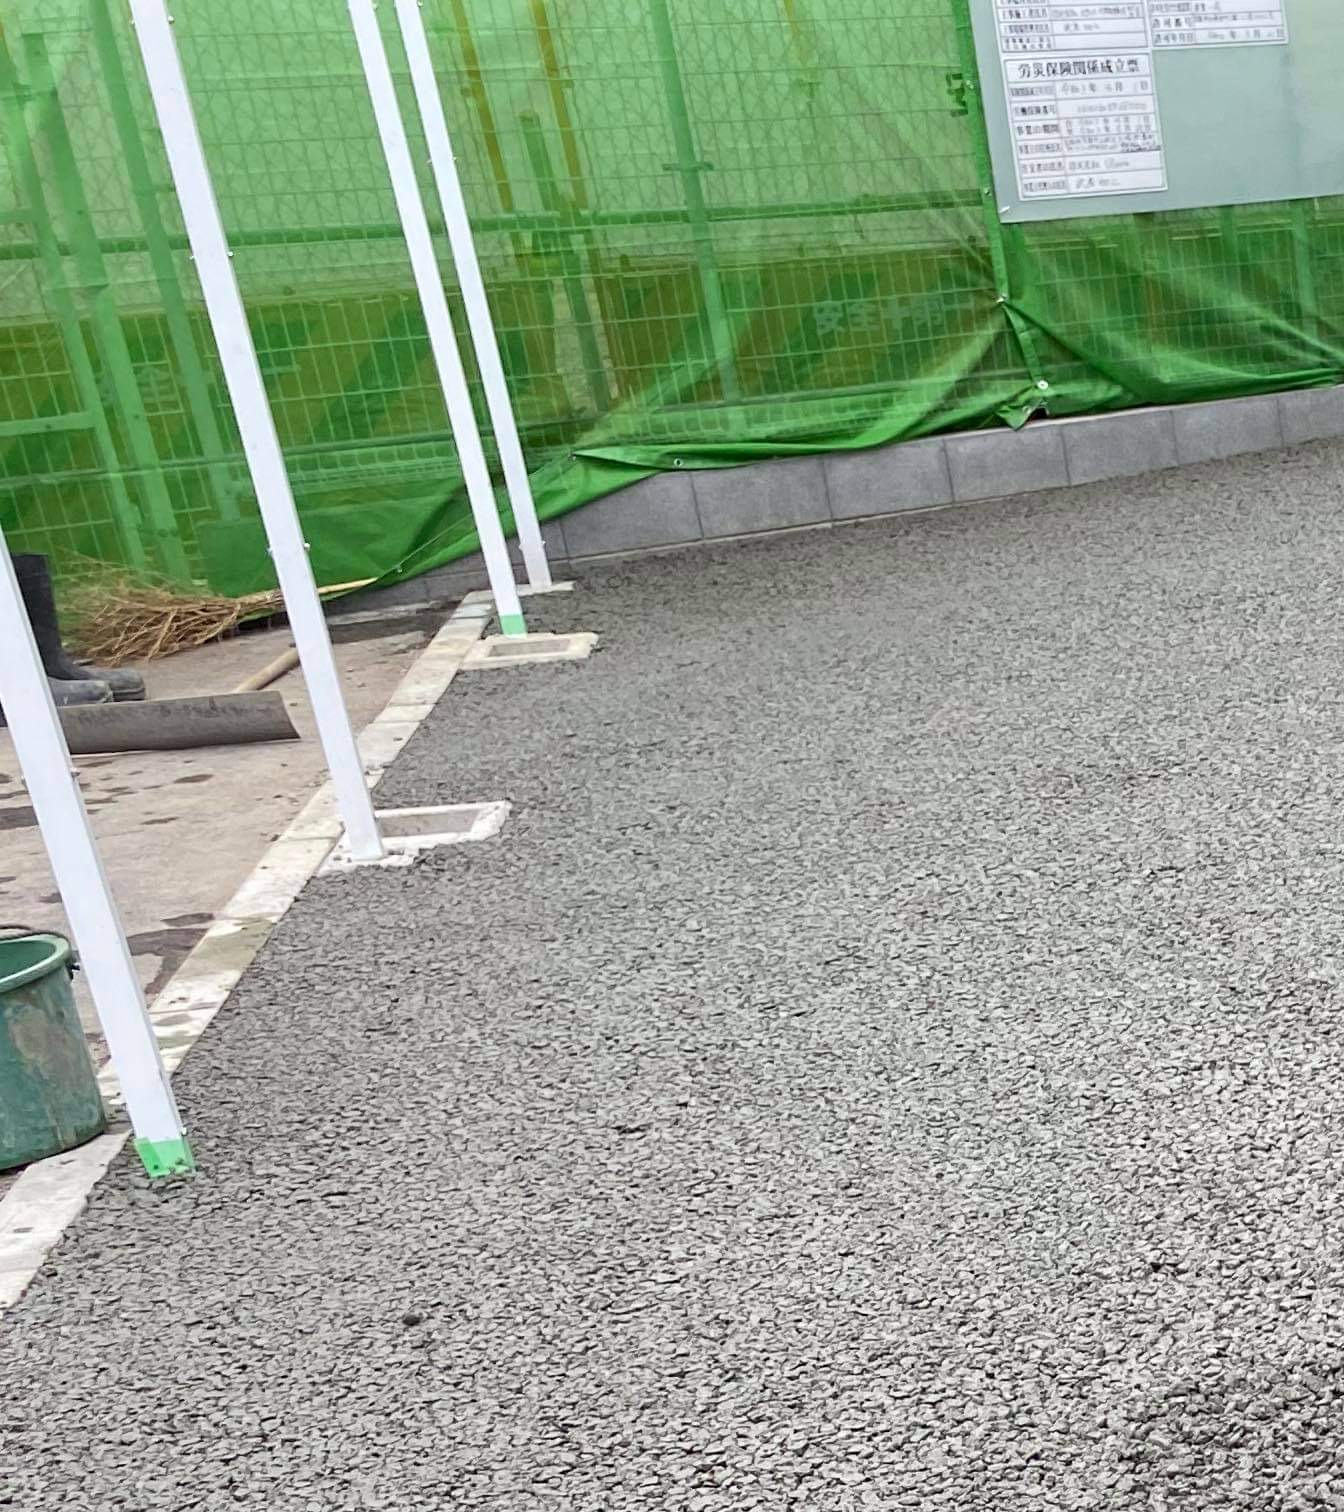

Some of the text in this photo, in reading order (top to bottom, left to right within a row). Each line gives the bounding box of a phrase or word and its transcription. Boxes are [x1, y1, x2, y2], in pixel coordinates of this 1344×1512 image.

[1017, 58, 1140, 78] 労災保険関係成立票
